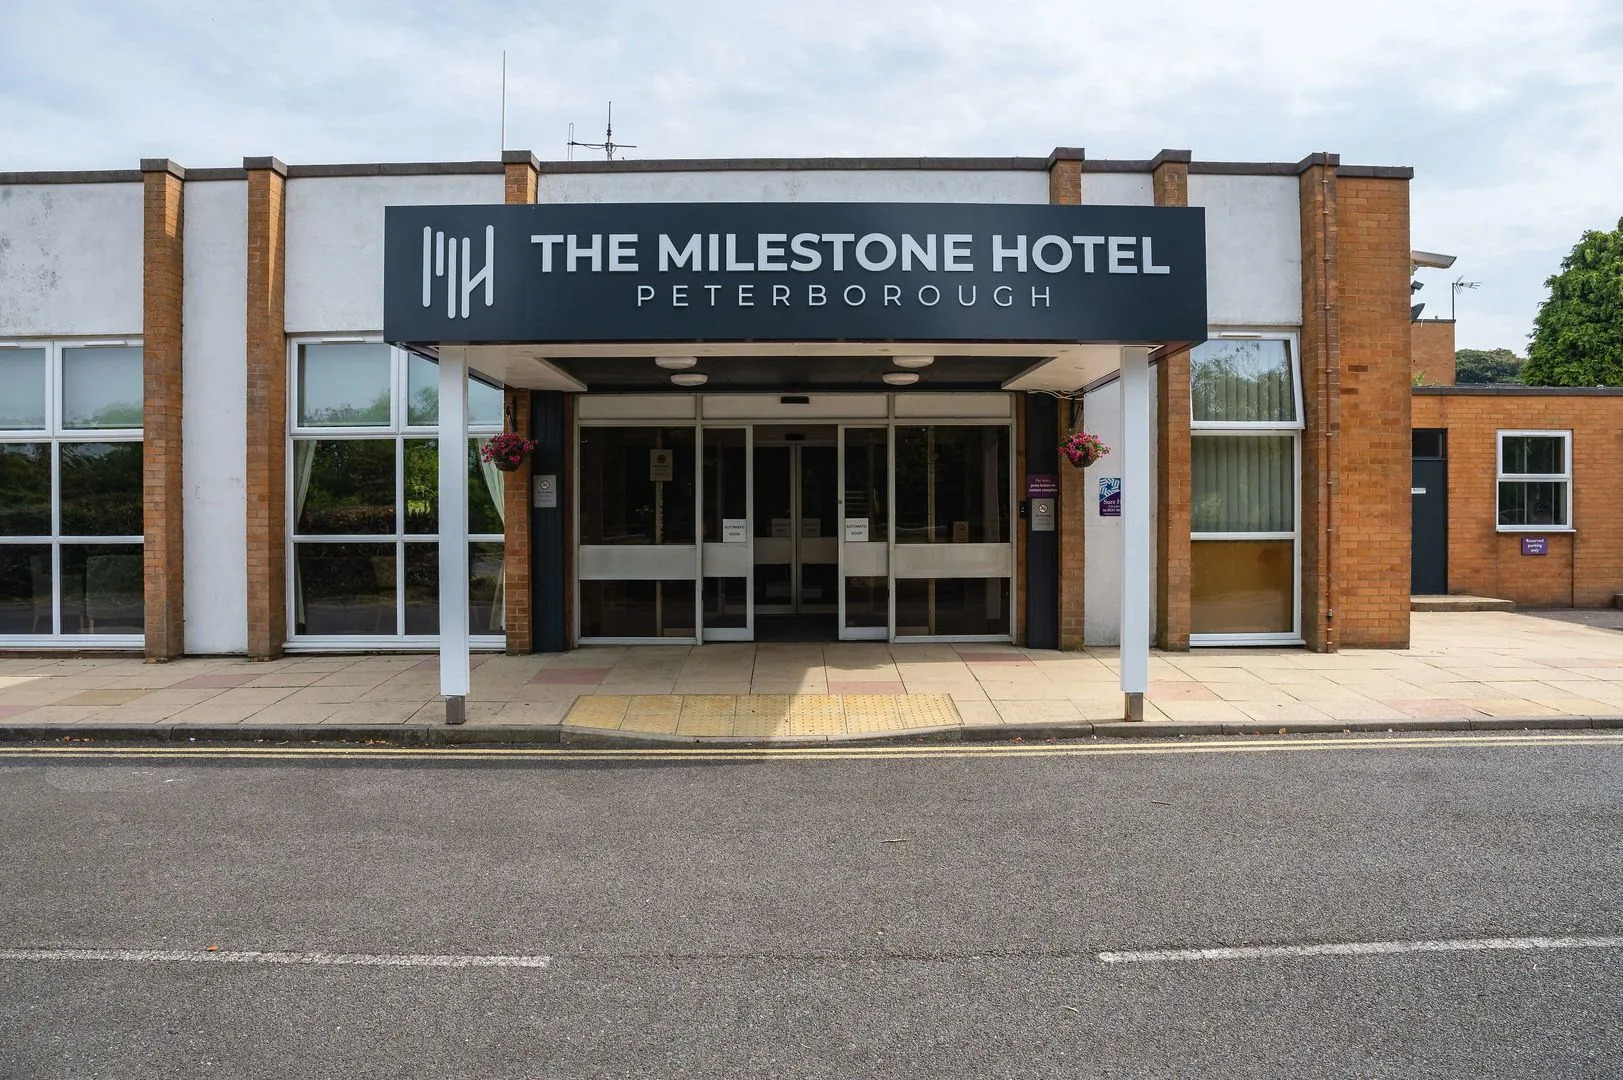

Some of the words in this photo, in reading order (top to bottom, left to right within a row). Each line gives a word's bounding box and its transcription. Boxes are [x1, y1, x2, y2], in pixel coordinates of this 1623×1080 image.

[530, 233, 639, 273] THE
[658, 232, 974, 273] MILESTONE
[992, 234, 1171, 275] HOTEL
[636, 284, 1051, 308] PETERBOROUGH
